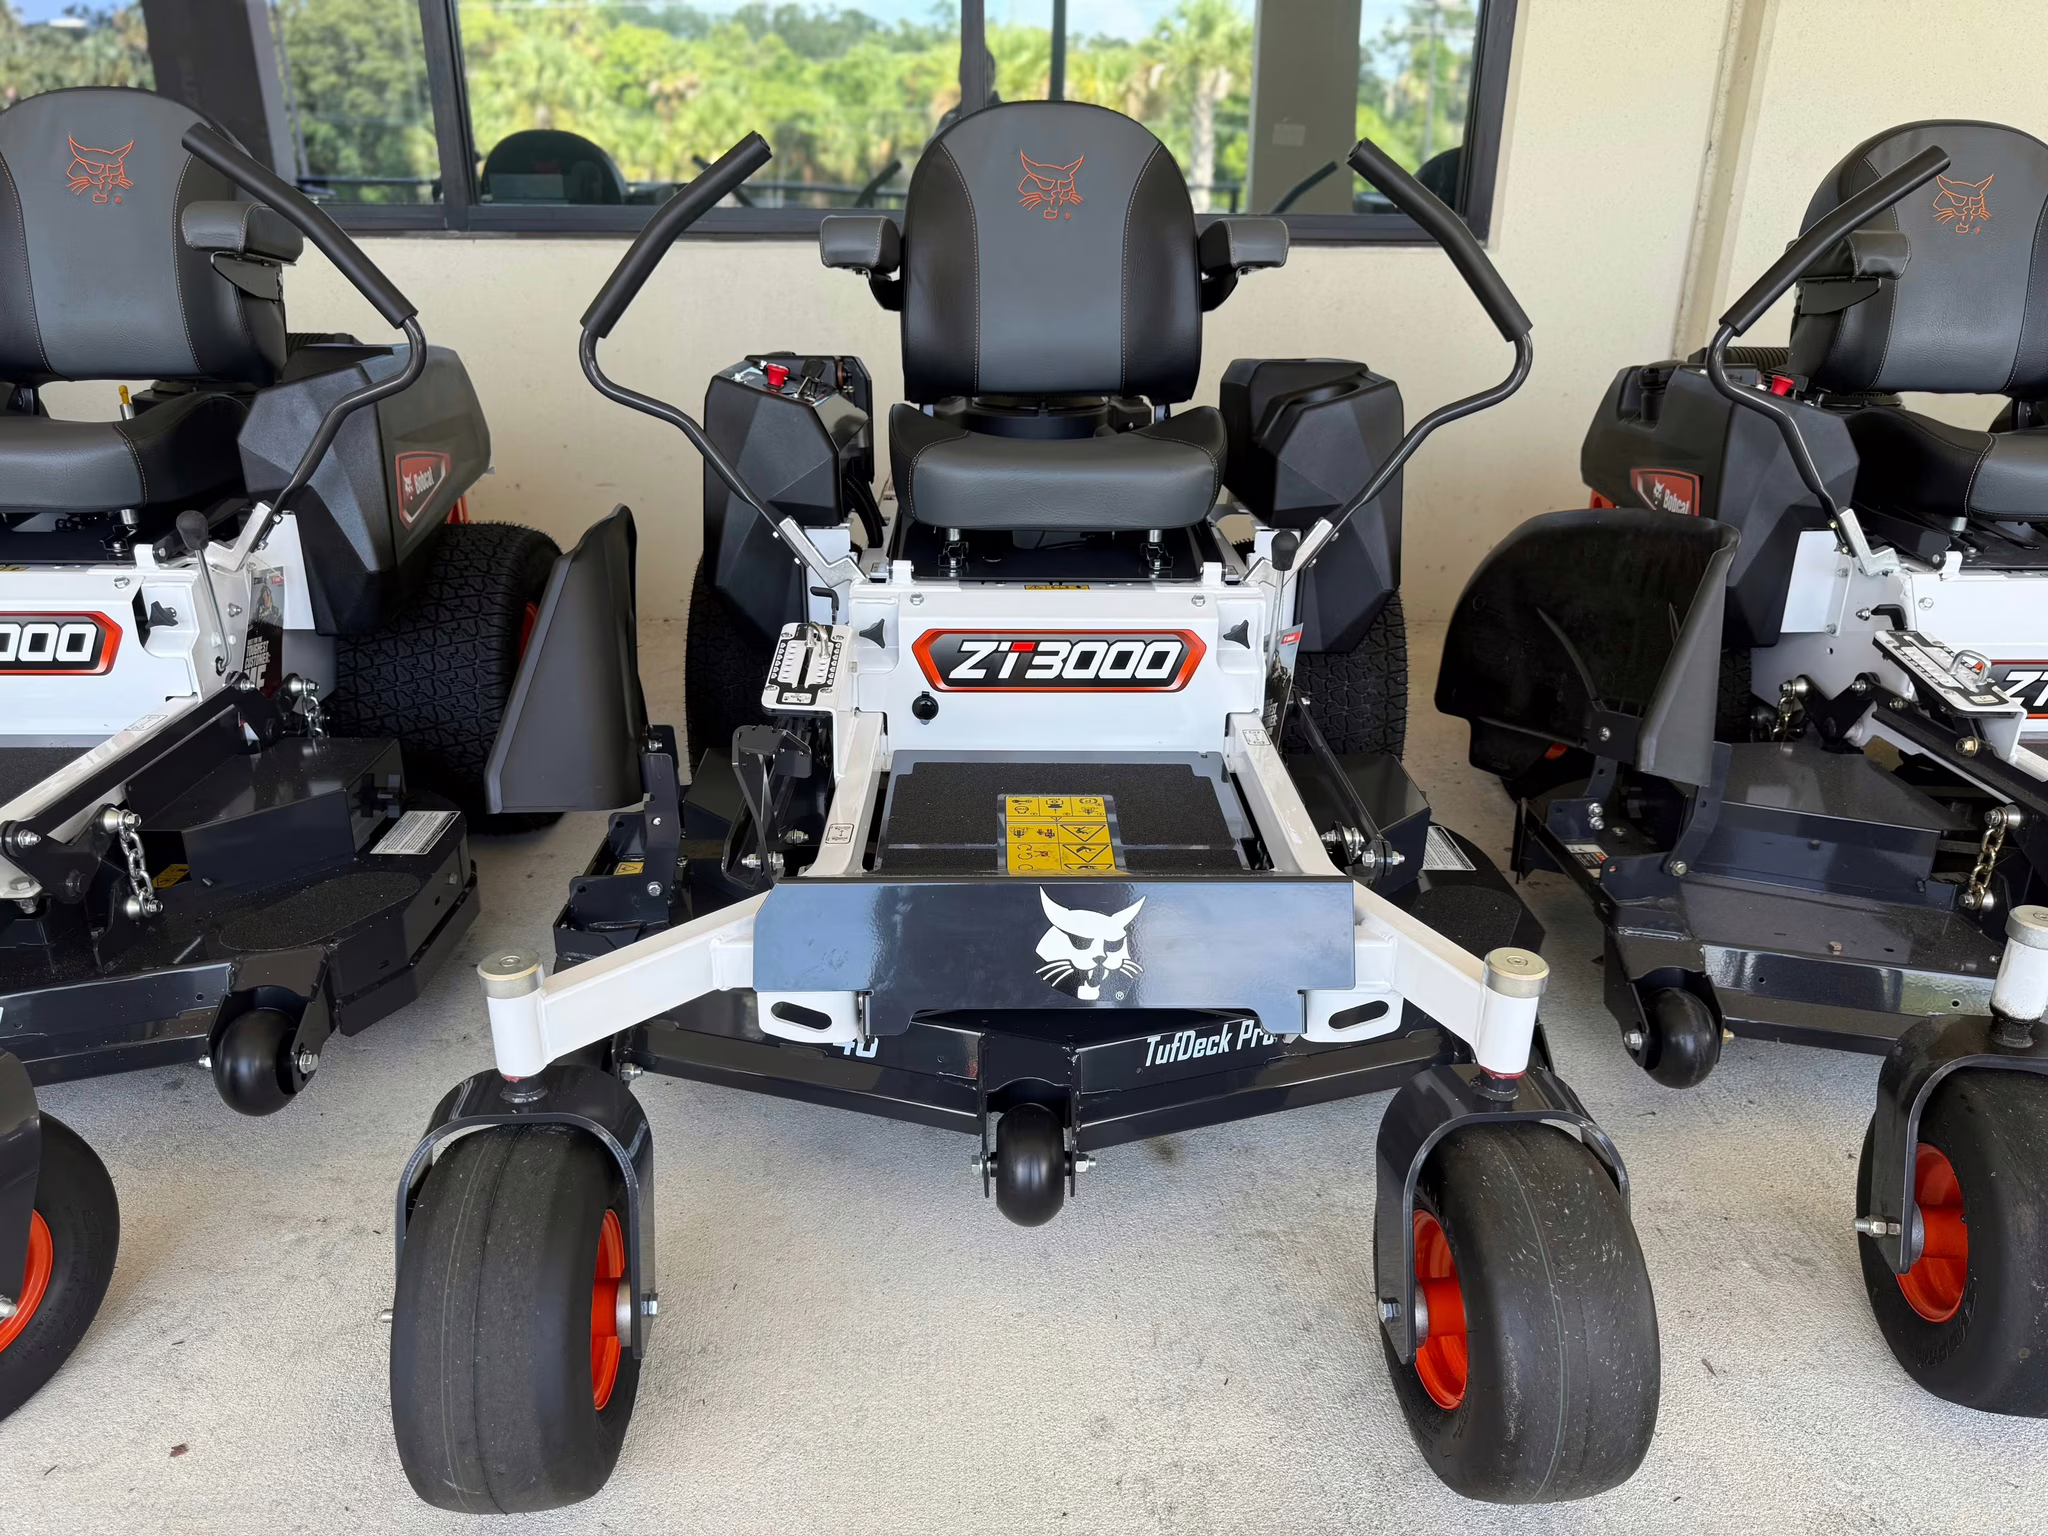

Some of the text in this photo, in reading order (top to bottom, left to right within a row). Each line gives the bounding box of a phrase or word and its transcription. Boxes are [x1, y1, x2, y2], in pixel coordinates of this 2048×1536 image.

[1663, 489, 1690, 514] Bobcat
[949, 641, 1182, 679] ZT3000
[1145, 1023, 1233, 1066] TufDeck
